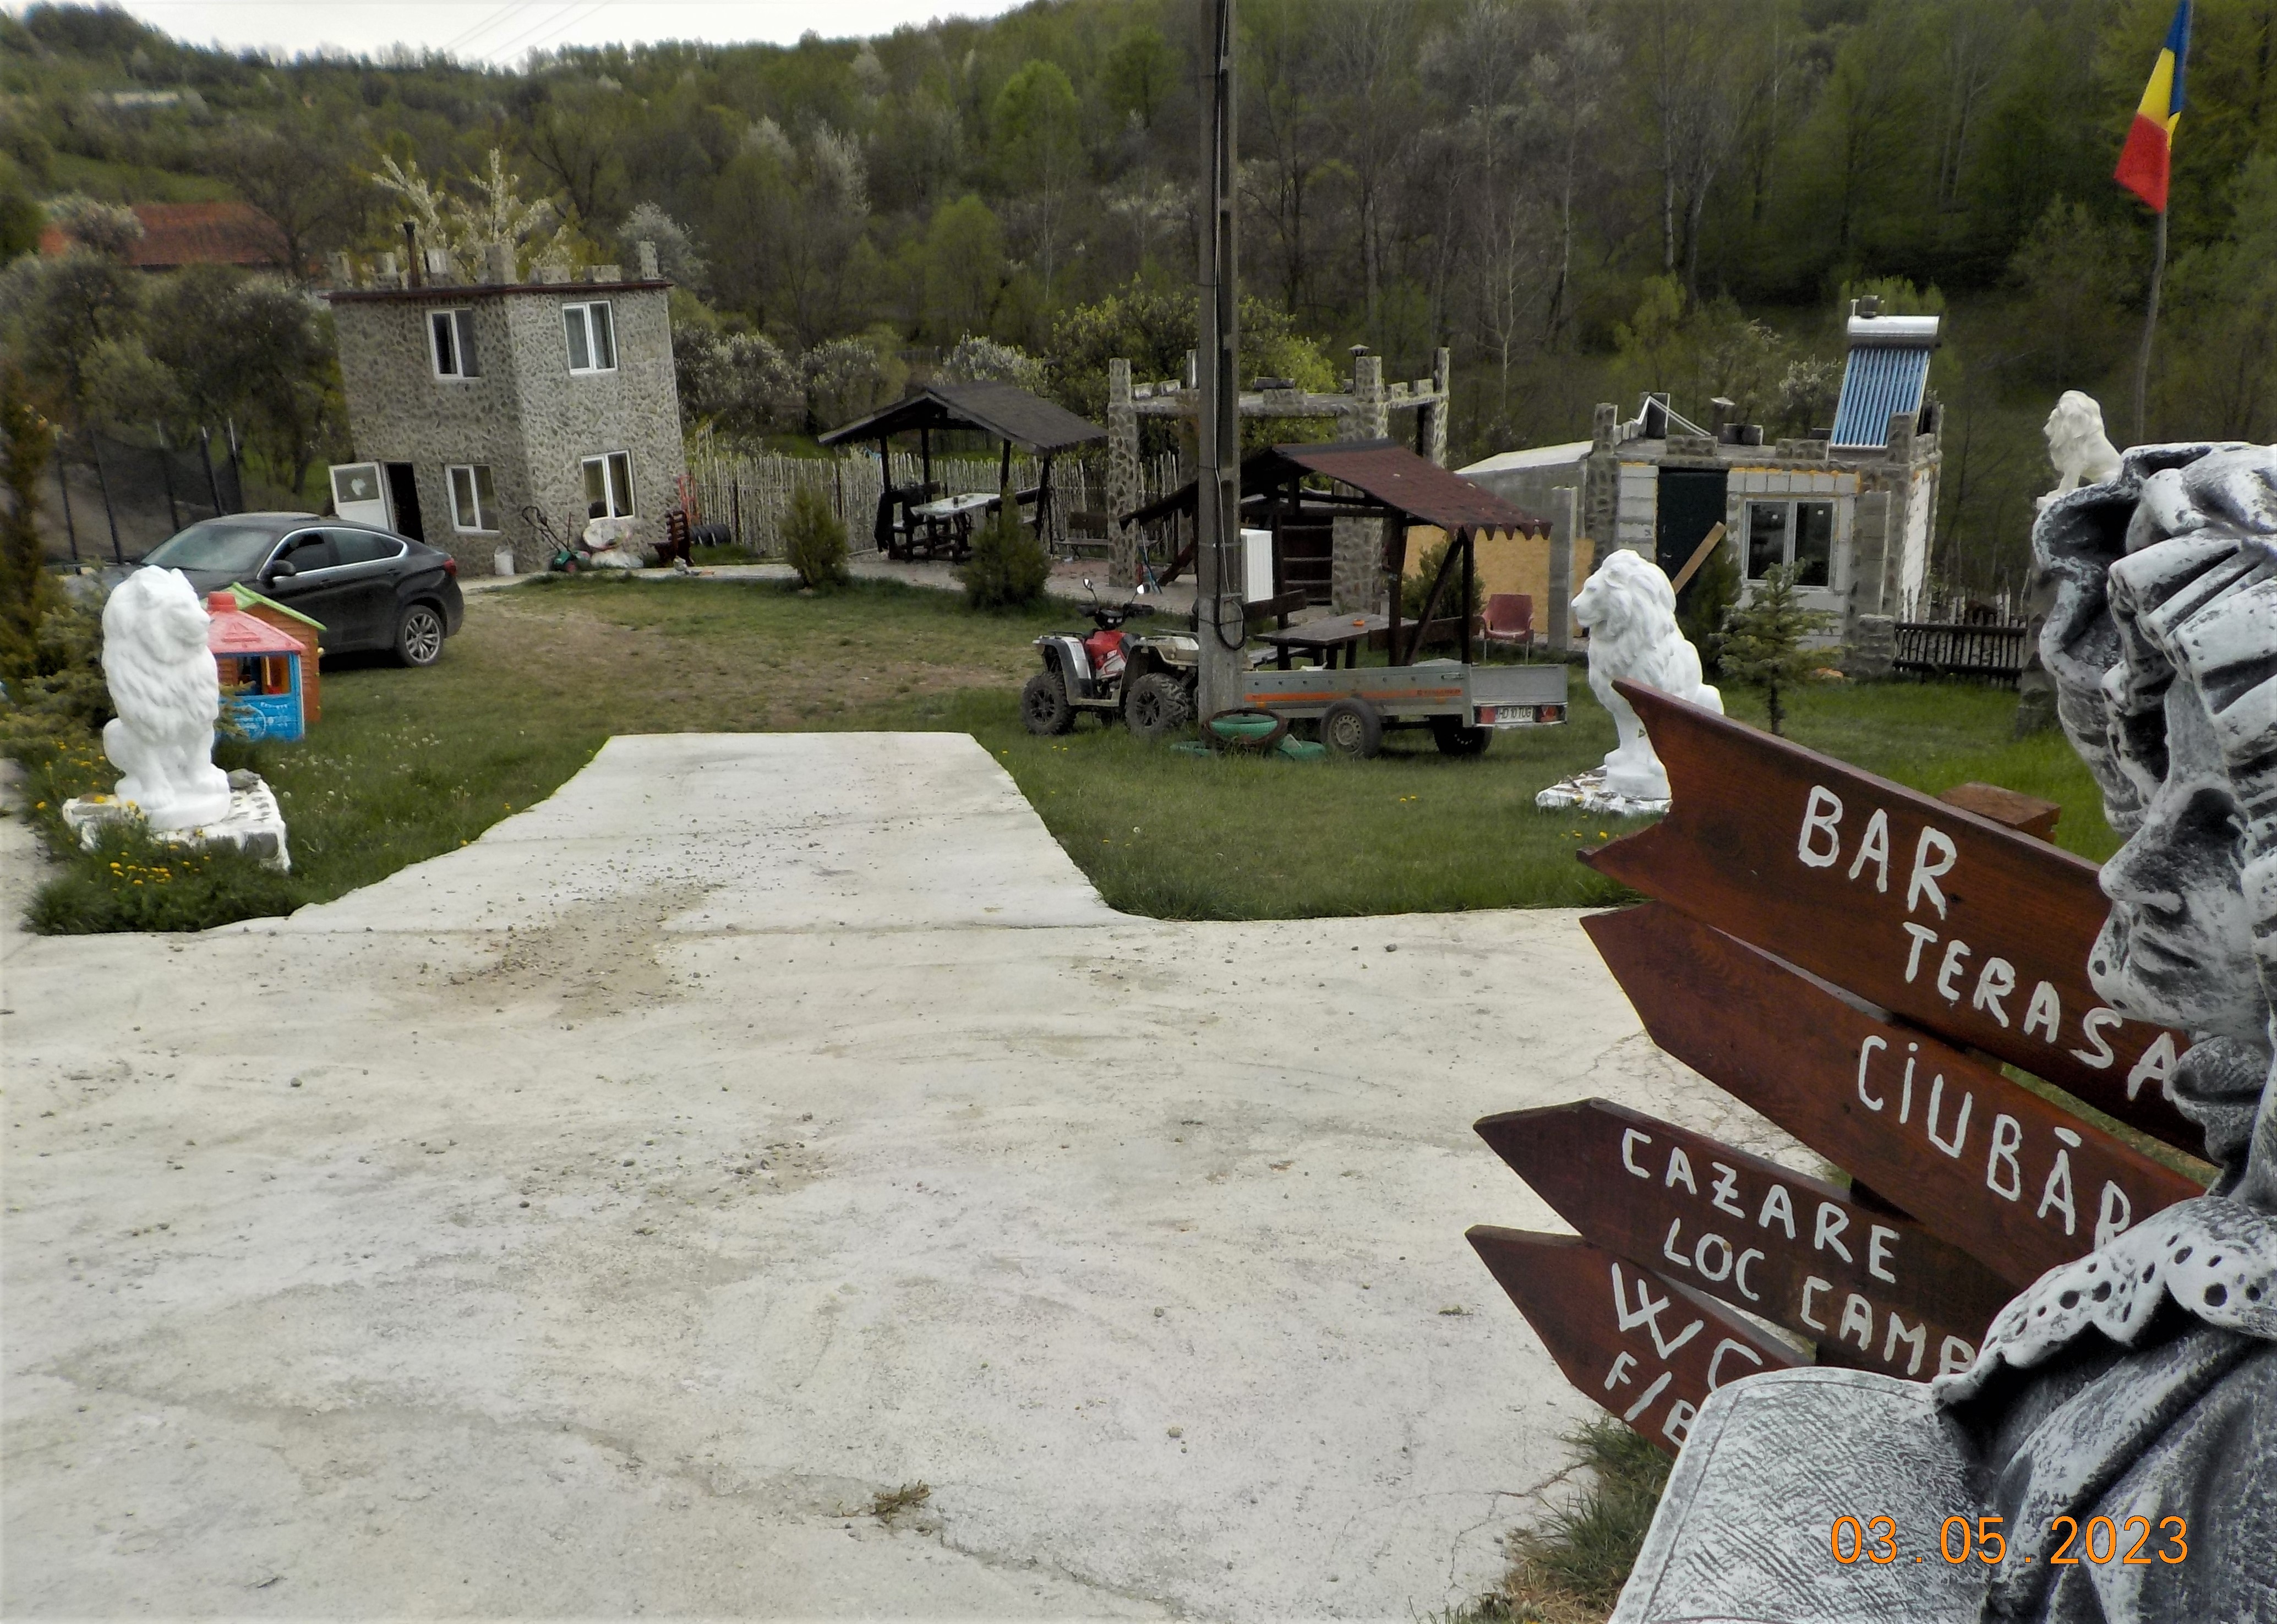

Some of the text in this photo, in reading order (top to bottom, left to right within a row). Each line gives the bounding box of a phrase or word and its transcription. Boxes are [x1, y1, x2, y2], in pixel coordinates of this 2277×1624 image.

[1498, 708, 1508, 719] HD
[1519, 707, 1531, 718] TUG
[1798, 785, 1957, 920] BAR
[1903, 921, 2178, 1101] TERASA
[1621, 1128, 1899, 1283] CAZARE
[1664, 1217, 1765, 1300] LOC
[1612, 1262, 1763, 1392] WC
[1604, 1351, 1697, 1447] F/B
